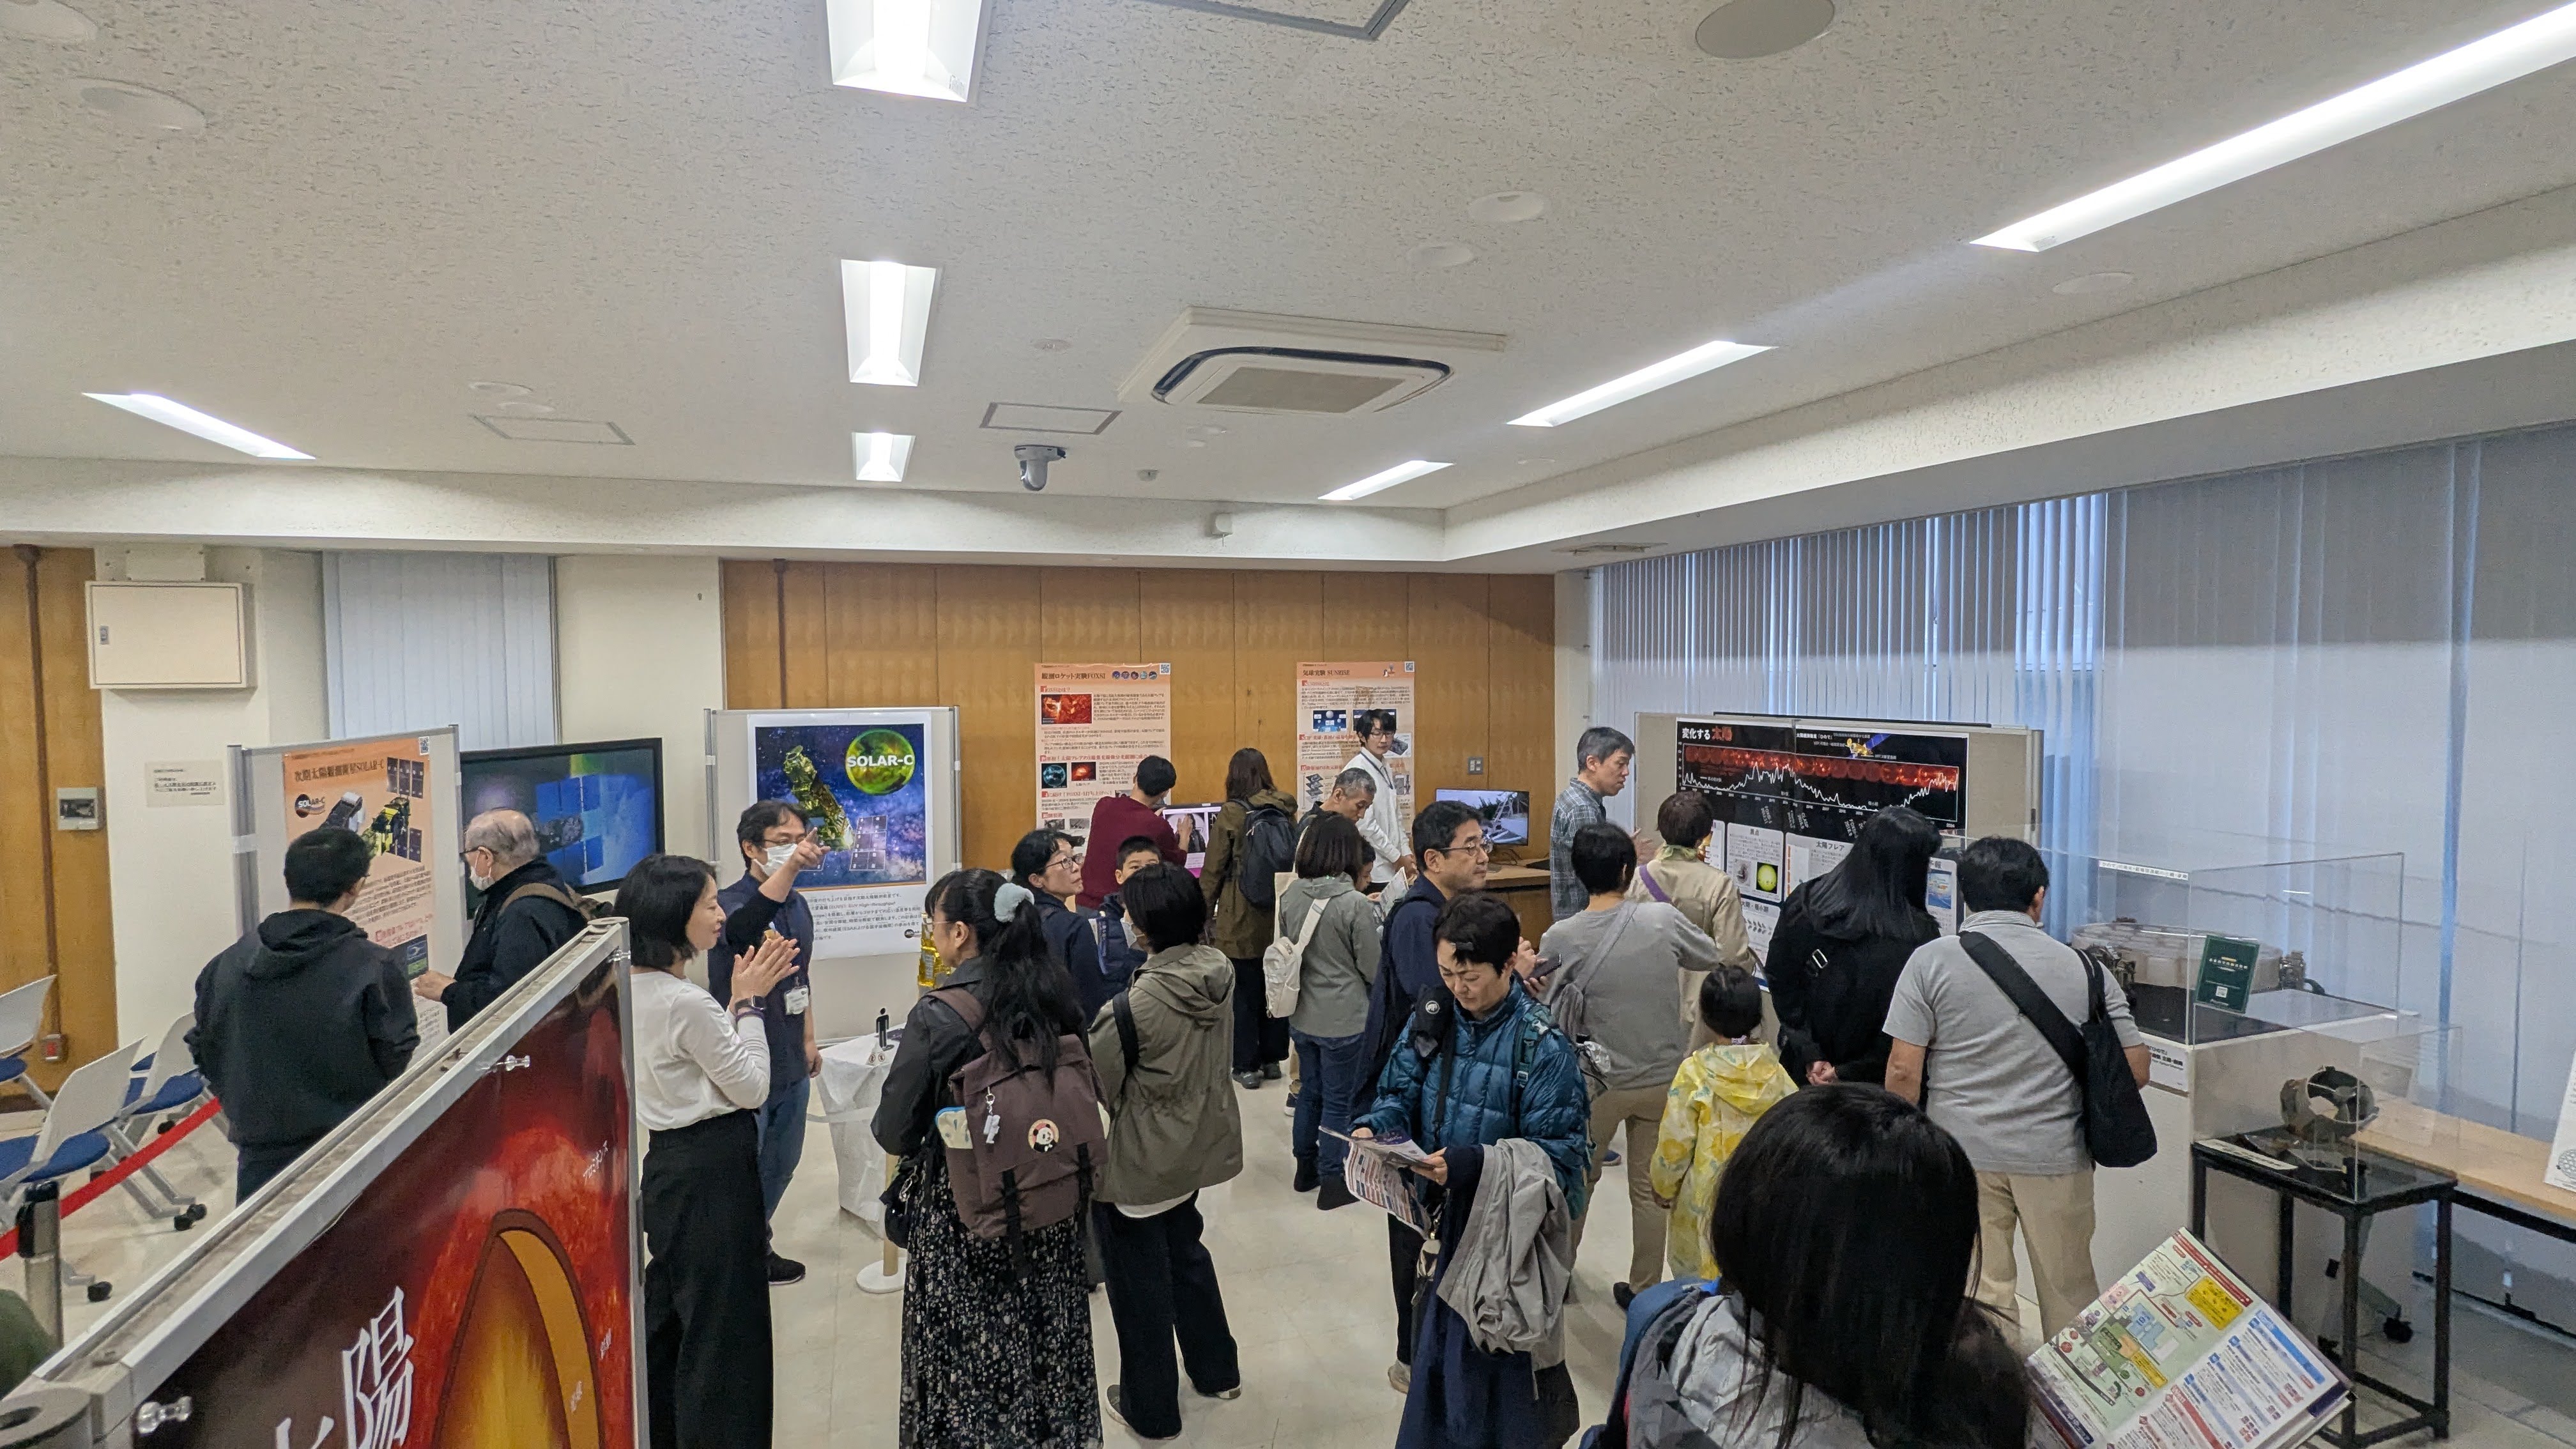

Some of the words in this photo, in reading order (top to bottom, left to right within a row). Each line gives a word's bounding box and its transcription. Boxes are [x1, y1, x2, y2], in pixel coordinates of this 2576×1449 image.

[847, 755, 914, 767] SOLAR-C
[1816, 841, 1845, 850] 太陽フレア
